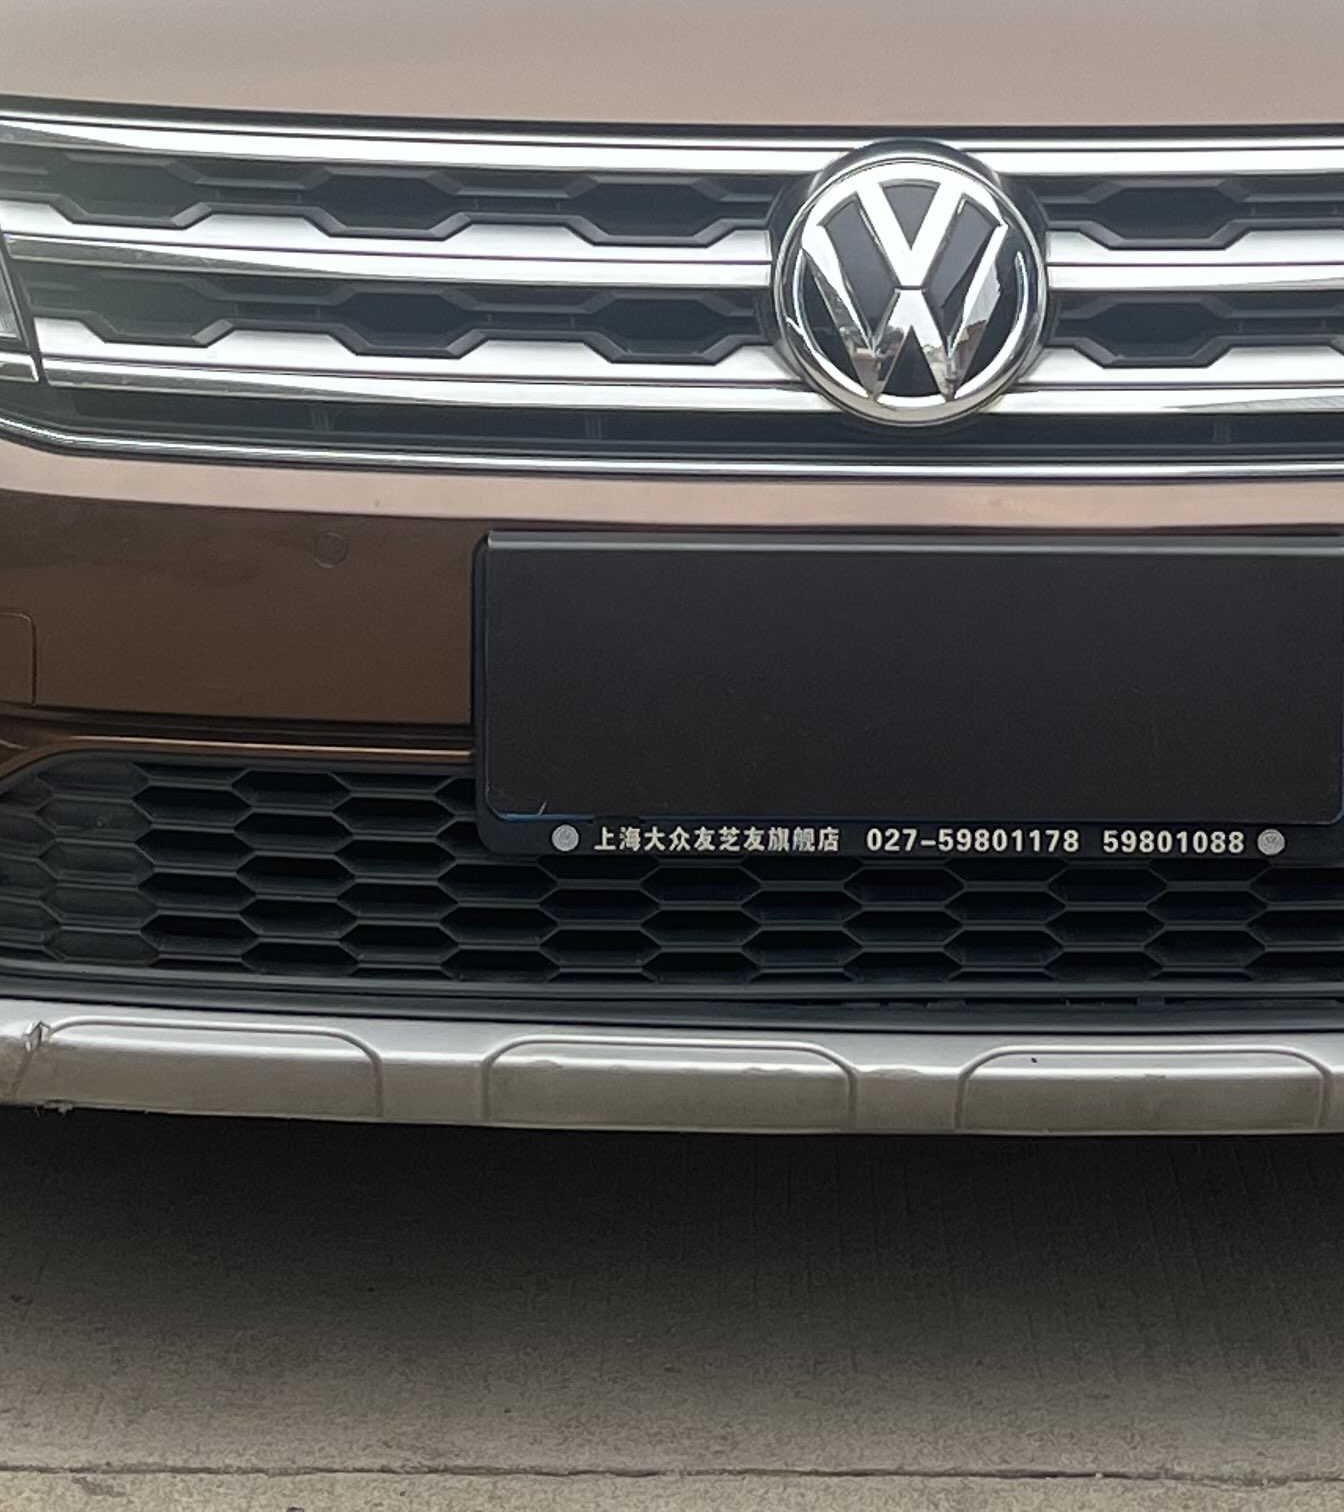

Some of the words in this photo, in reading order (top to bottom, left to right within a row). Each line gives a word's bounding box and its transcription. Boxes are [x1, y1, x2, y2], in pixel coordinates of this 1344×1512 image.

[593, 826, 840, 852] 上海大众友芝友旗舰店
[865, 828, 1080, 853] 027-59801178
[1102, 829, 1245, 854] 59801088
